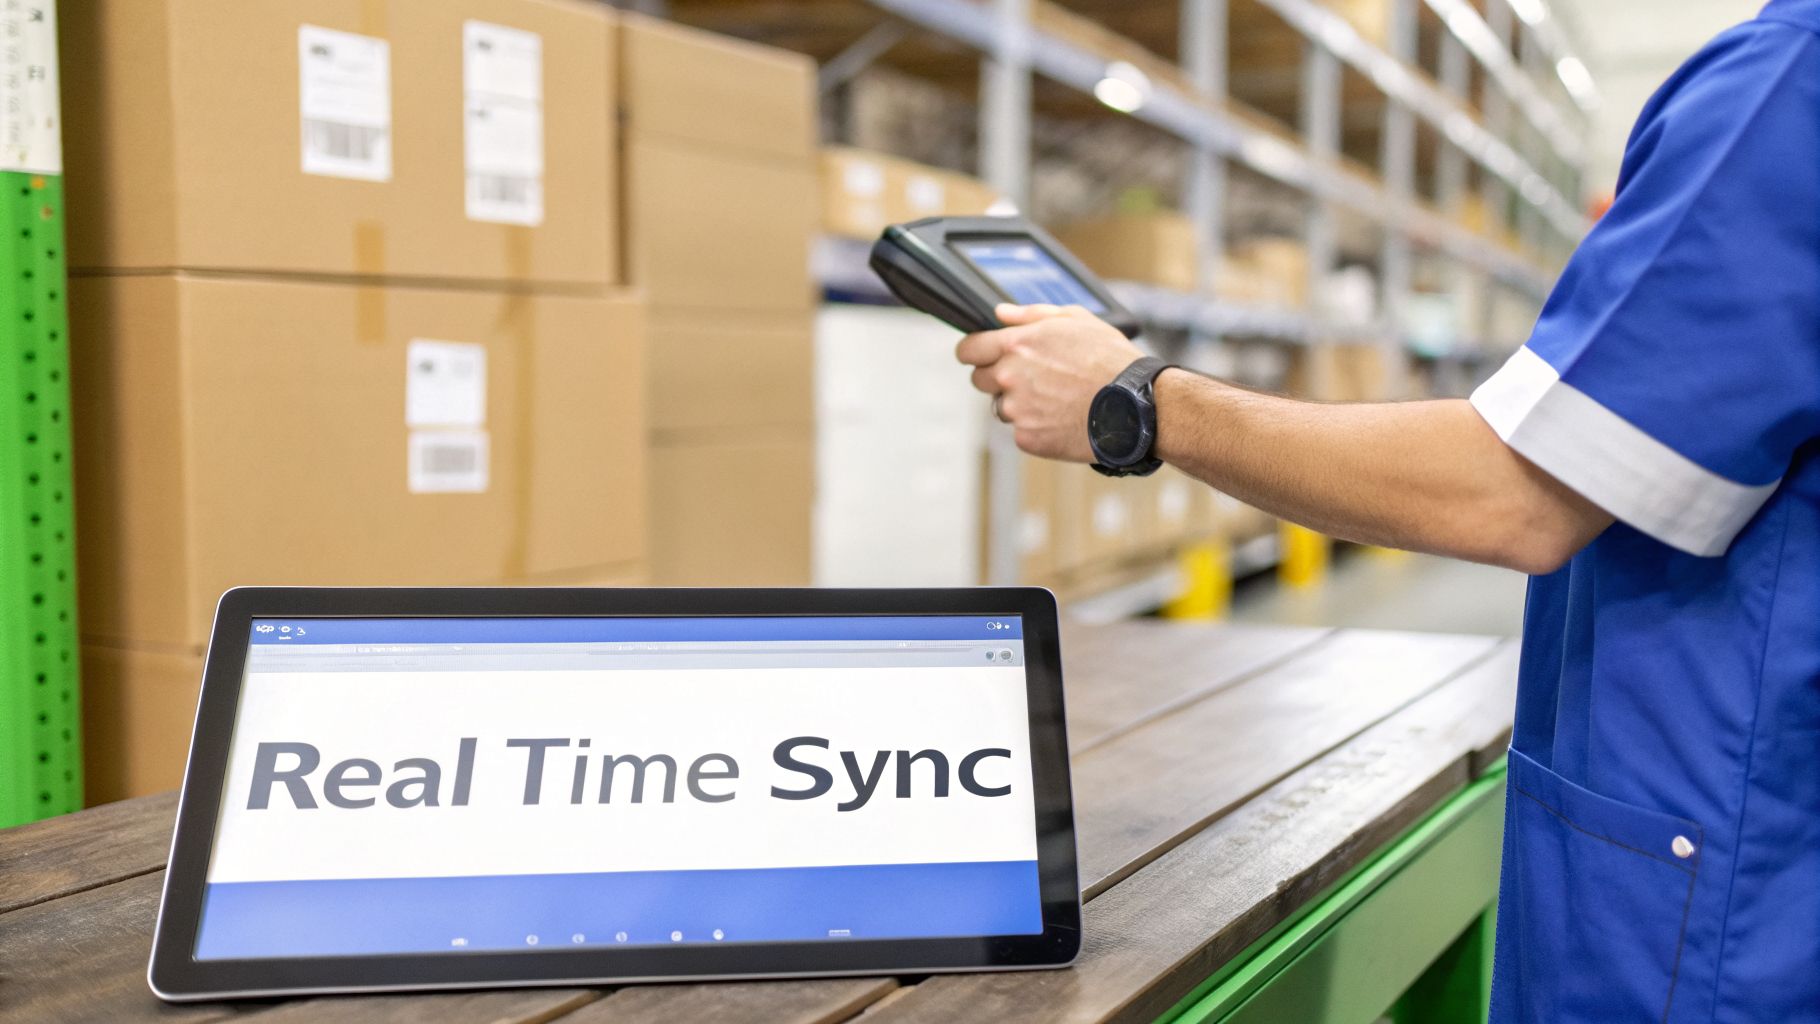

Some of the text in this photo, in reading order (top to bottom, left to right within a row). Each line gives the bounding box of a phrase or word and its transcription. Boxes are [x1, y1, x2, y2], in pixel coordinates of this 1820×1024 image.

[247, 736, 1012, 812] Real Time Sync
